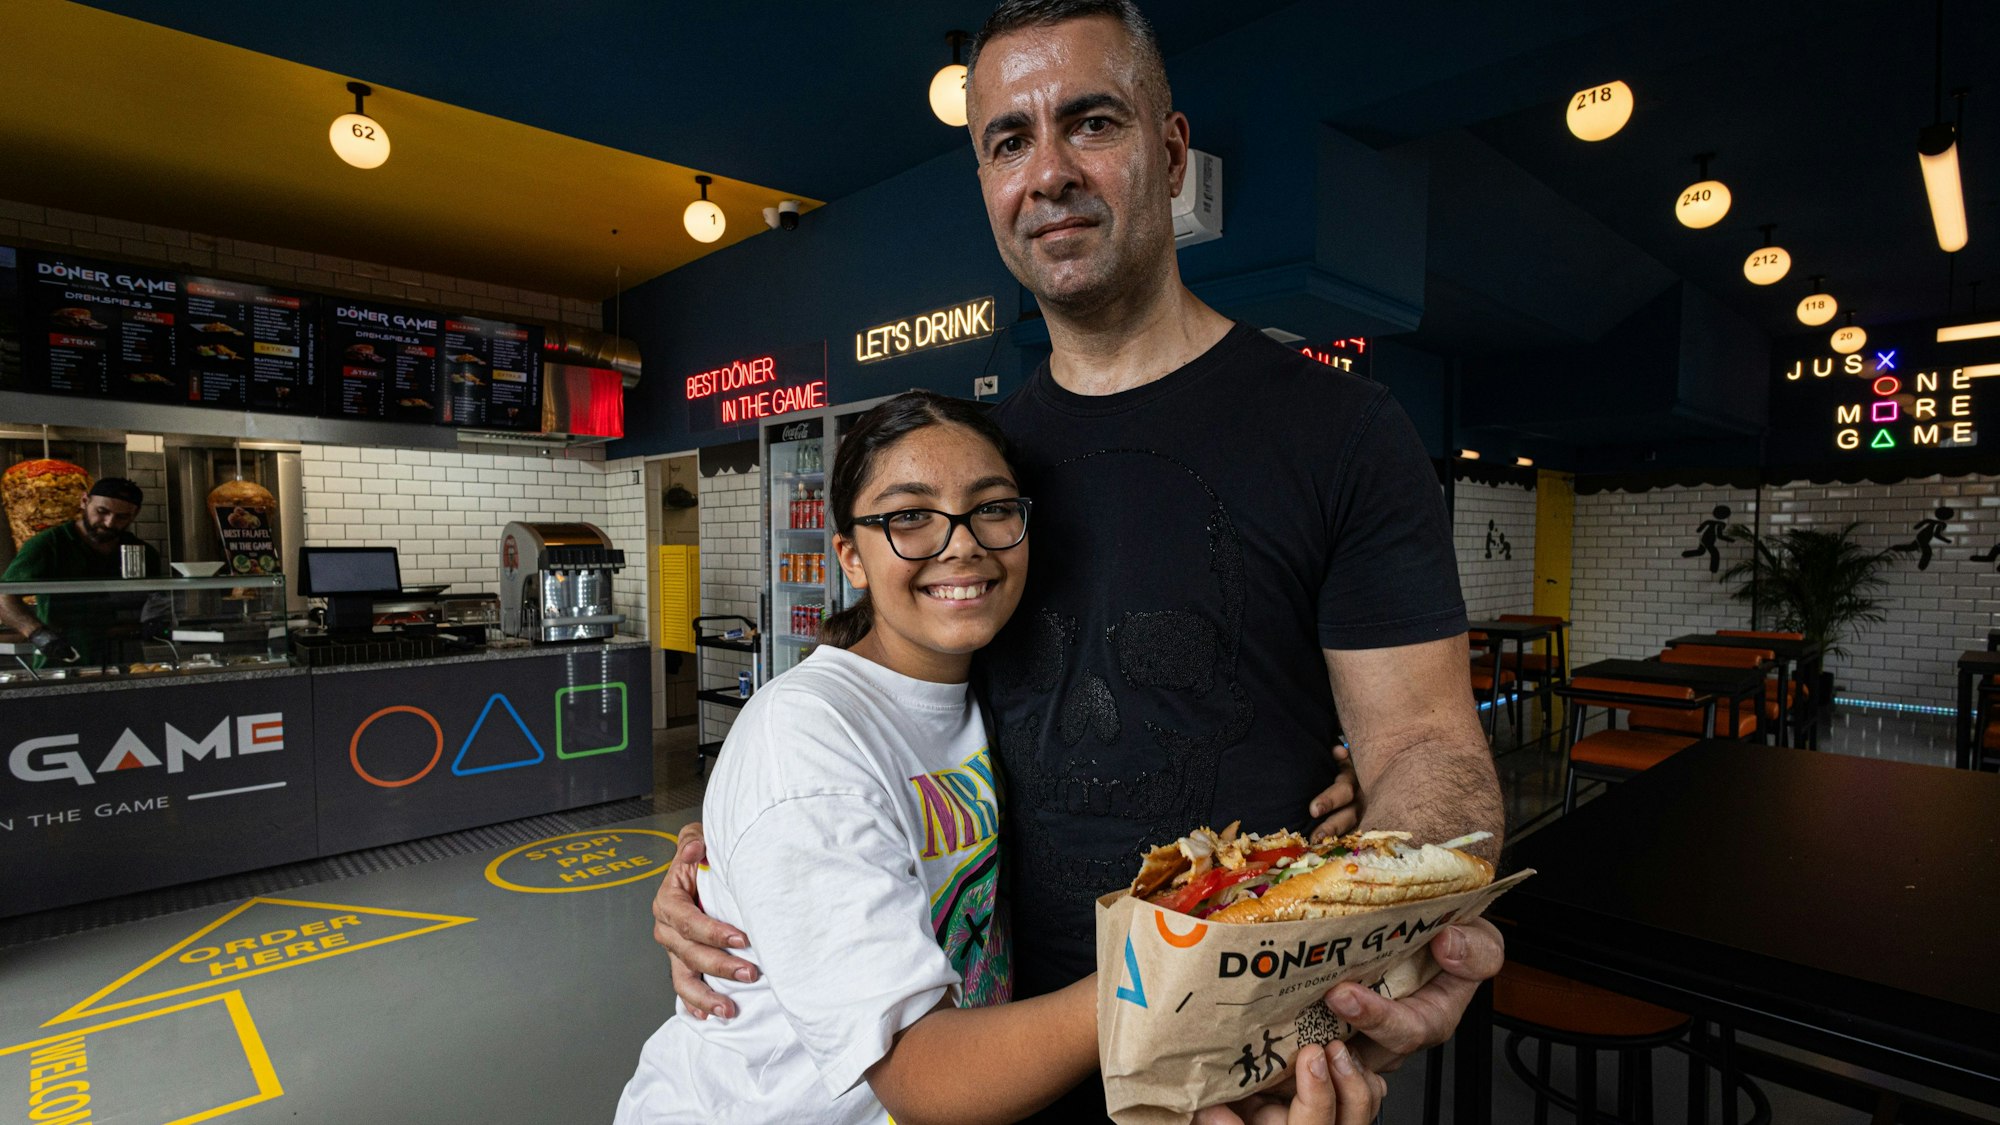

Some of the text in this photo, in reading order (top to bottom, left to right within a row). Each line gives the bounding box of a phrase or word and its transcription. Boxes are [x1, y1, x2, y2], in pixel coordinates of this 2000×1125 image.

[1576, 87, 1612, 111] 218
[351, 123, 375, 141] 62
[1683, 189, 1711, 206] 240
[710, 213, 717, 225] 1
[1753, 254, 1778, 267] 212
[37, 261, 111, 287] DÖNER
[115, 275, 177, 293] GAME
[336, 305, 390, 327] DÖNER
[392, 315, 438, 331] GAME
[1805, 301, 1825, 311] 118
[856, 300, 991, 362] LET'S DRINK
[1840, 332, 1853, 341] 20
[686, 357, 775, 399] BEST DÖNER
[722, 381, 824, 423] IN THE GAME
[223, 528, 270, 538] BEST FALAFEL
[229, 541, 273, 551] IN THE GAME
[8, 712, 284, 785] GAME
[27, 809, 82, 828] THE
[94, 796, 170, 818] GAME
[524, 834, 623, 861] STOP!
[557, 847, 617, 868] PAY
[559, 855, 653, 883] HERE
[179, 914, 362, 964] ORDER
[209, 932, 350, 977] HERE
[1218, 940, 1352, 980] DÖNER
[1278, 983, 1302, 997] BEST
[1304, 971, 1338, 989] DÖNER
